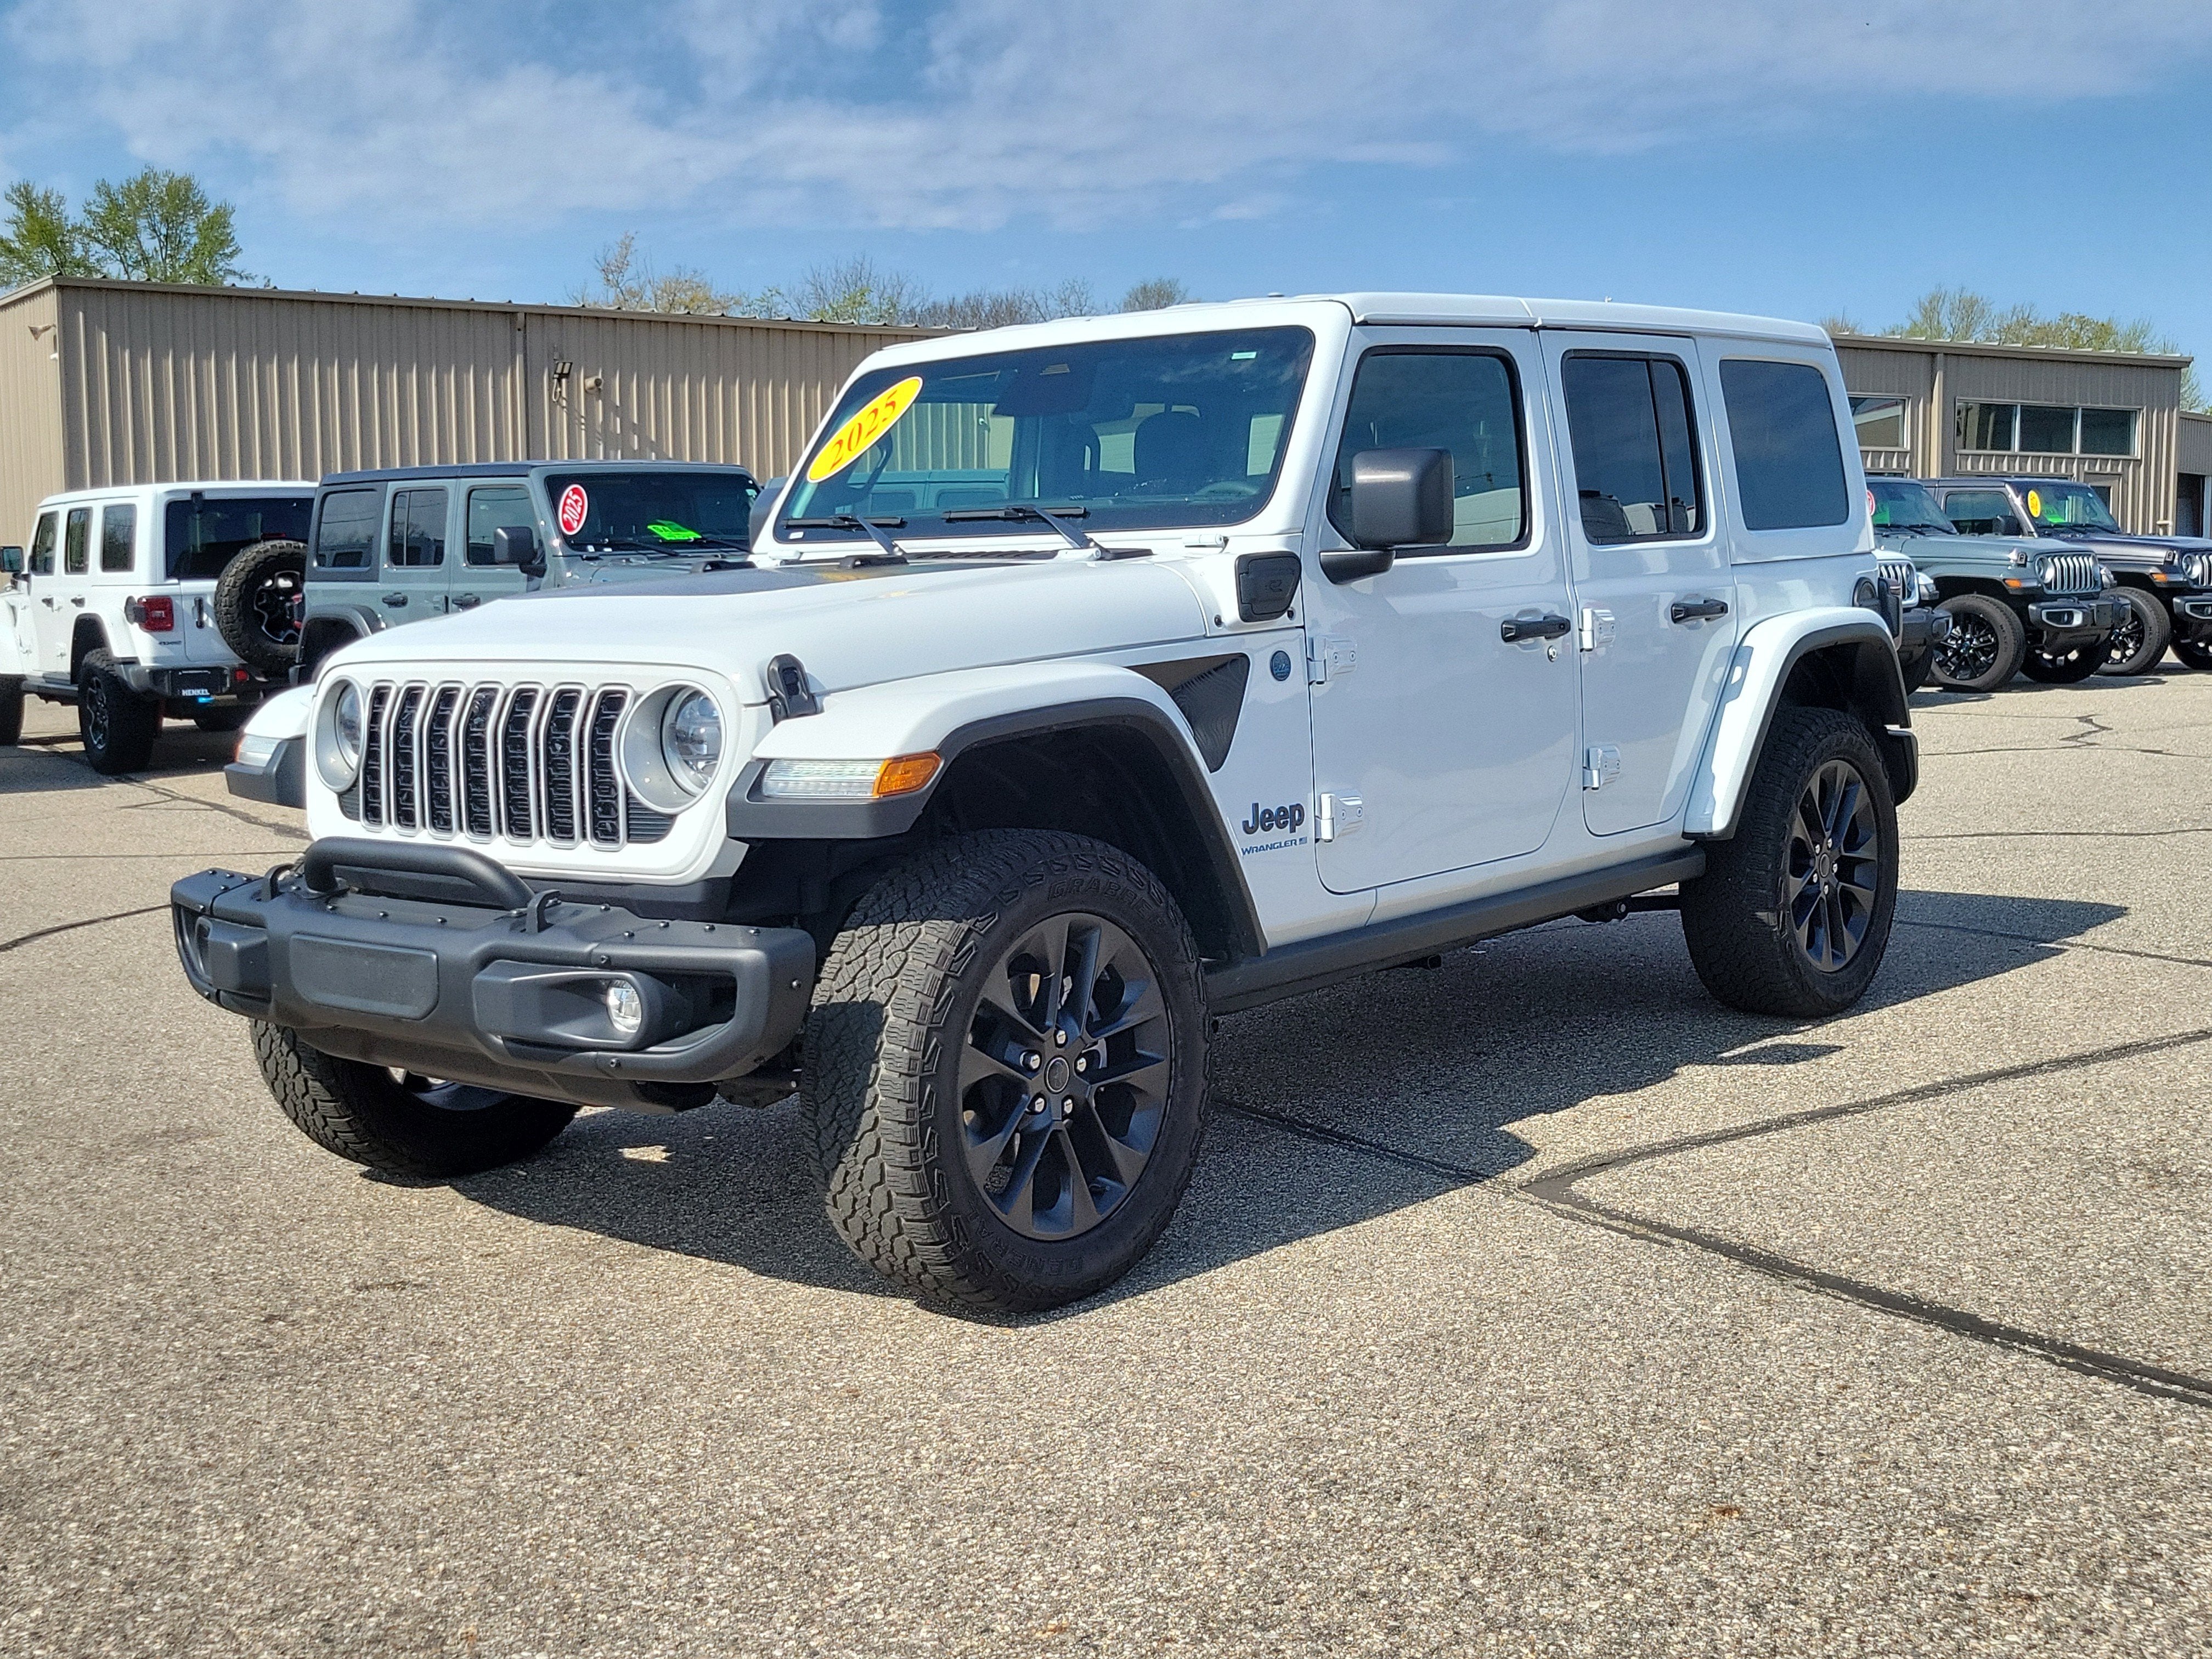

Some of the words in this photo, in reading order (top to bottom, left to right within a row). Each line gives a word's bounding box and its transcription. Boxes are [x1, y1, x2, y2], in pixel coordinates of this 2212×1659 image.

[830, 390, 898, 472] 2025
[563, 490, 583, 529] 2025
[1242, 802, 1305, 835] Jeep
[1240, 838, 1298, 855] WRANGLER
